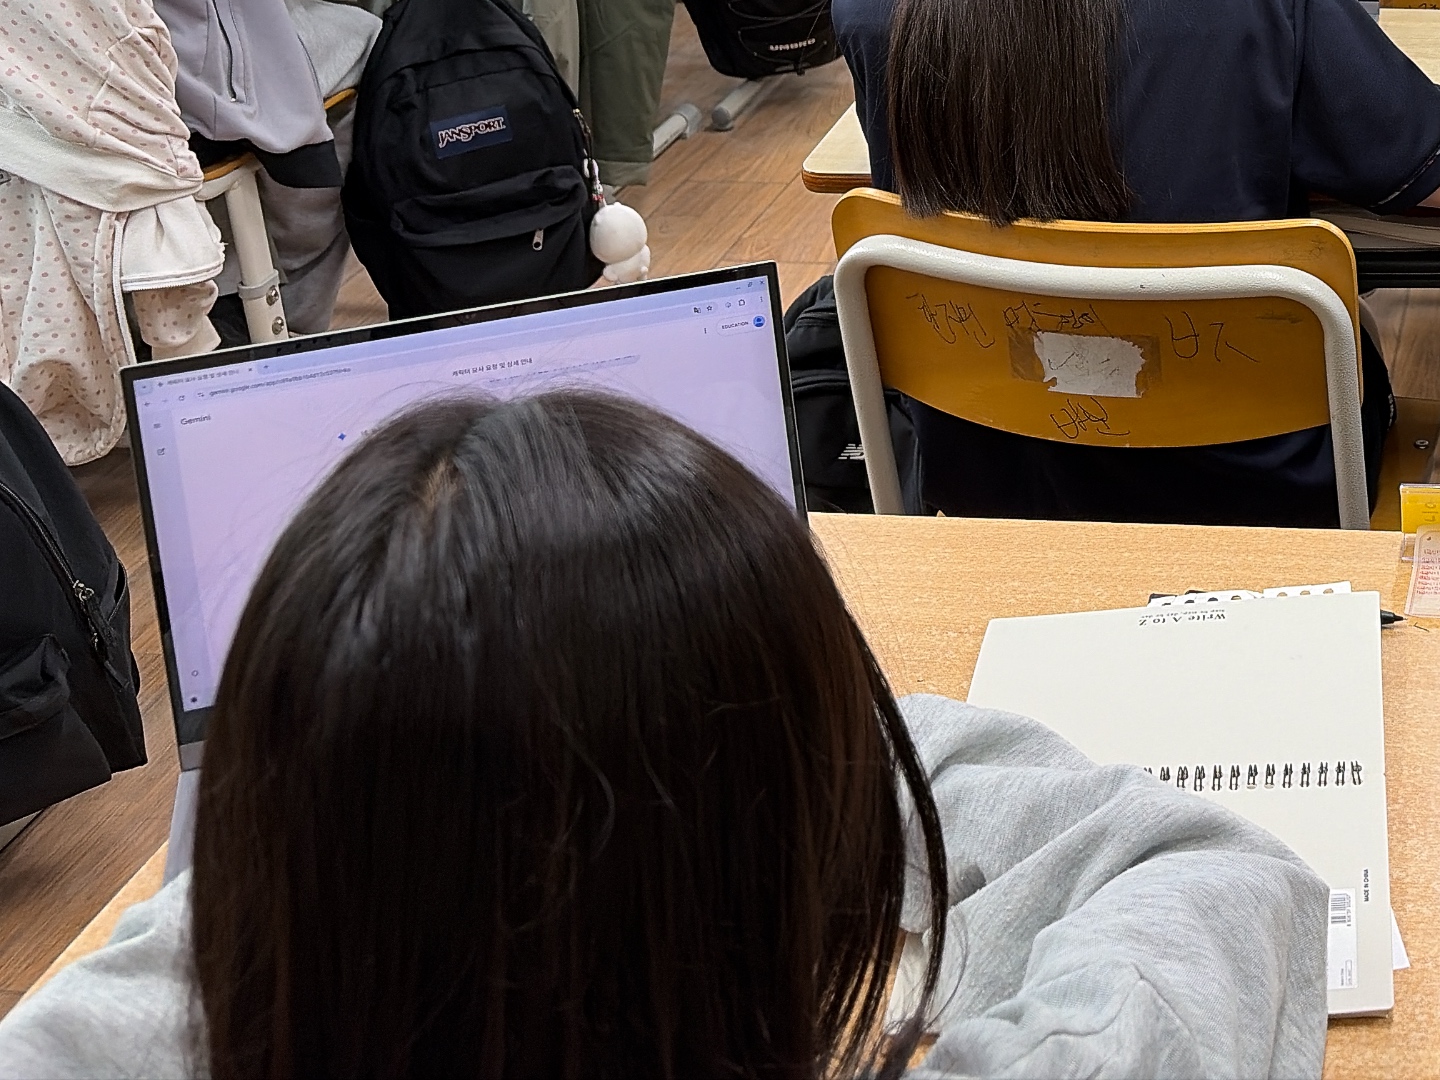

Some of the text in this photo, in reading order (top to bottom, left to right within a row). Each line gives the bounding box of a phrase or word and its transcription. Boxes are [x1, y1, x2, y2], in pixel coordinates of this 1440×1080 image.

[722, 321, 749, 329] EDUCATION
[181, 414, 211, 426] Gemini
[1188, 614, 1226, 622] Write
